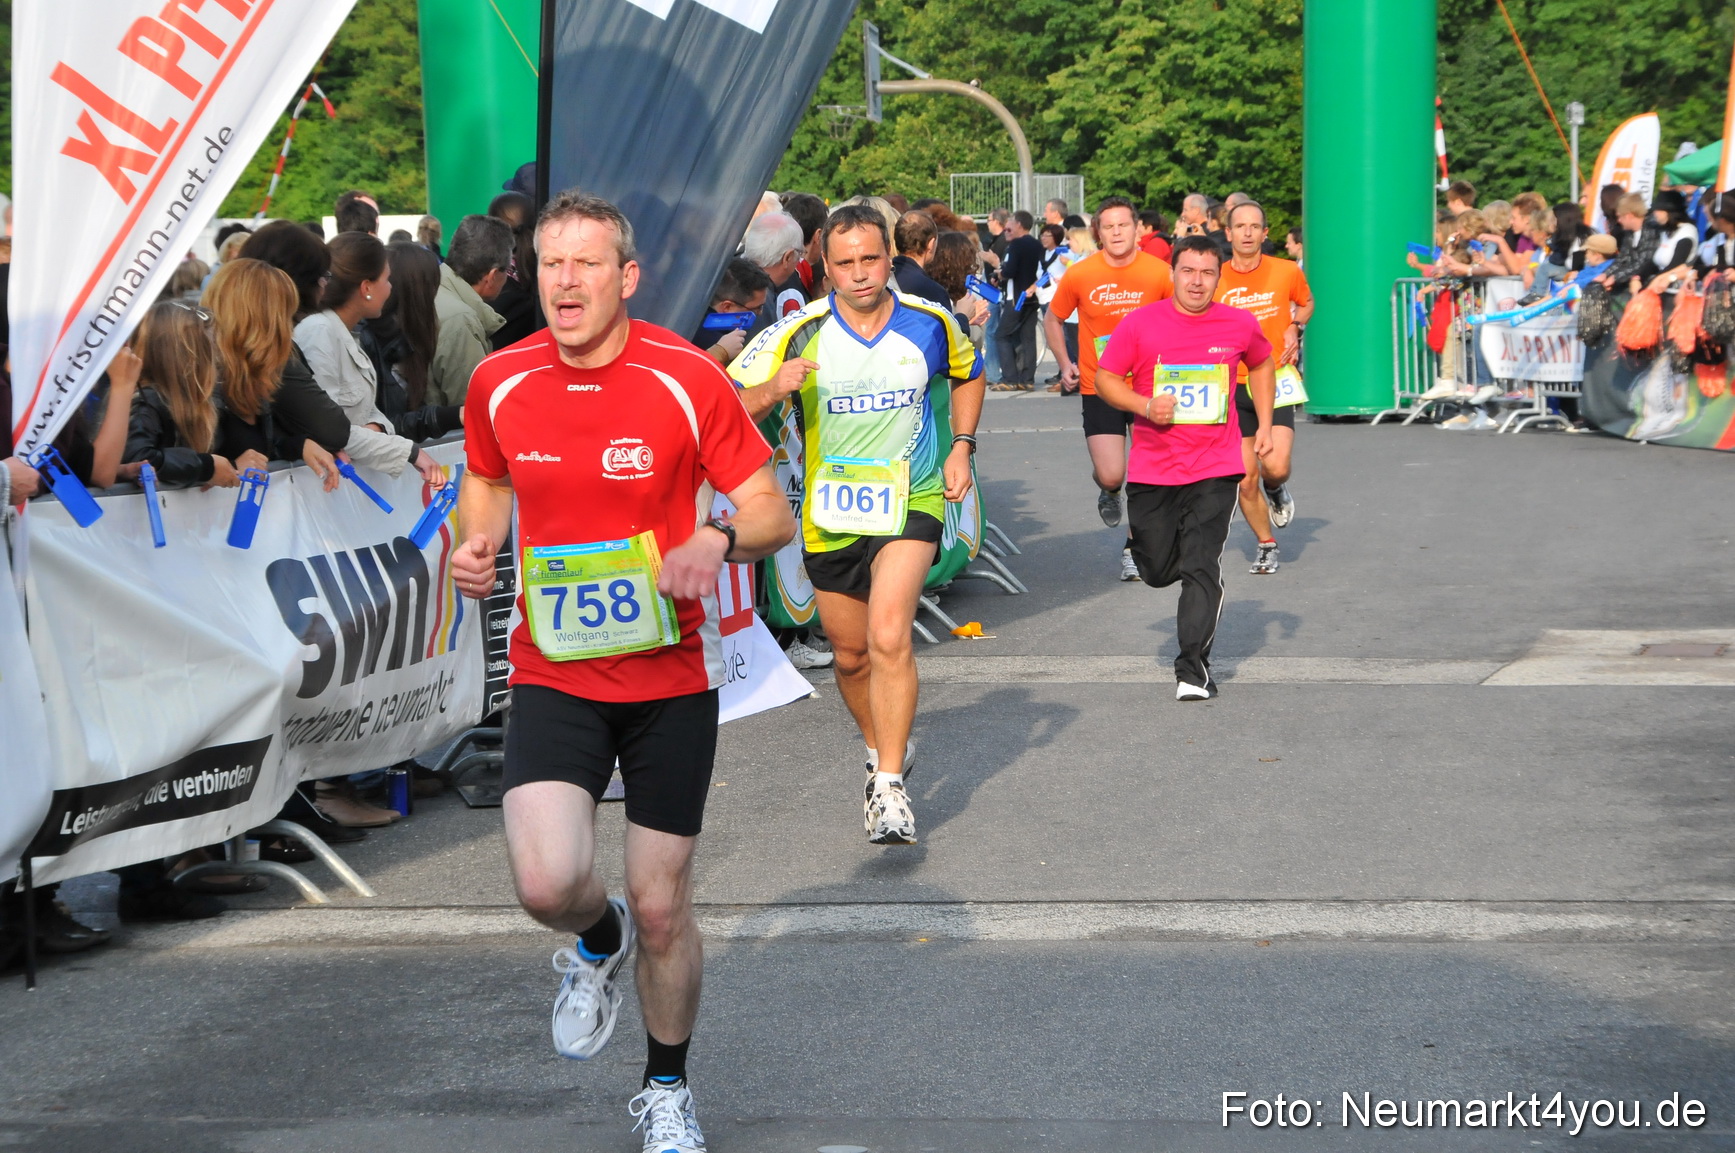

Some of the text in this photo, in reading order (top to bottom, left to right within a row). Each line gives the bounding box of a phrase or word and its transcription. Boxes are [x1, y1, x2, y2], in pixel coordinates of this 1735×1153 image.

[50, 61, 180, 206] XL
[1099, 287, 1144, 301] Fischer
[1229, 288, 1275, 306] Fischer
[567, 384, 595, 392] CRAFT
[830, 377, 888, 394] TEAM
[827, 388, 918, 415] BOCK
[817, 483, 890, 515] 1061
[540, 567, 583, 580] firmenlauf
[541, 579, 641, 631] 758
[555, 630, 609, 643] Wolfgang
[144, 779, 169, 806] die
[172, 765, 254, 801] verbinden
